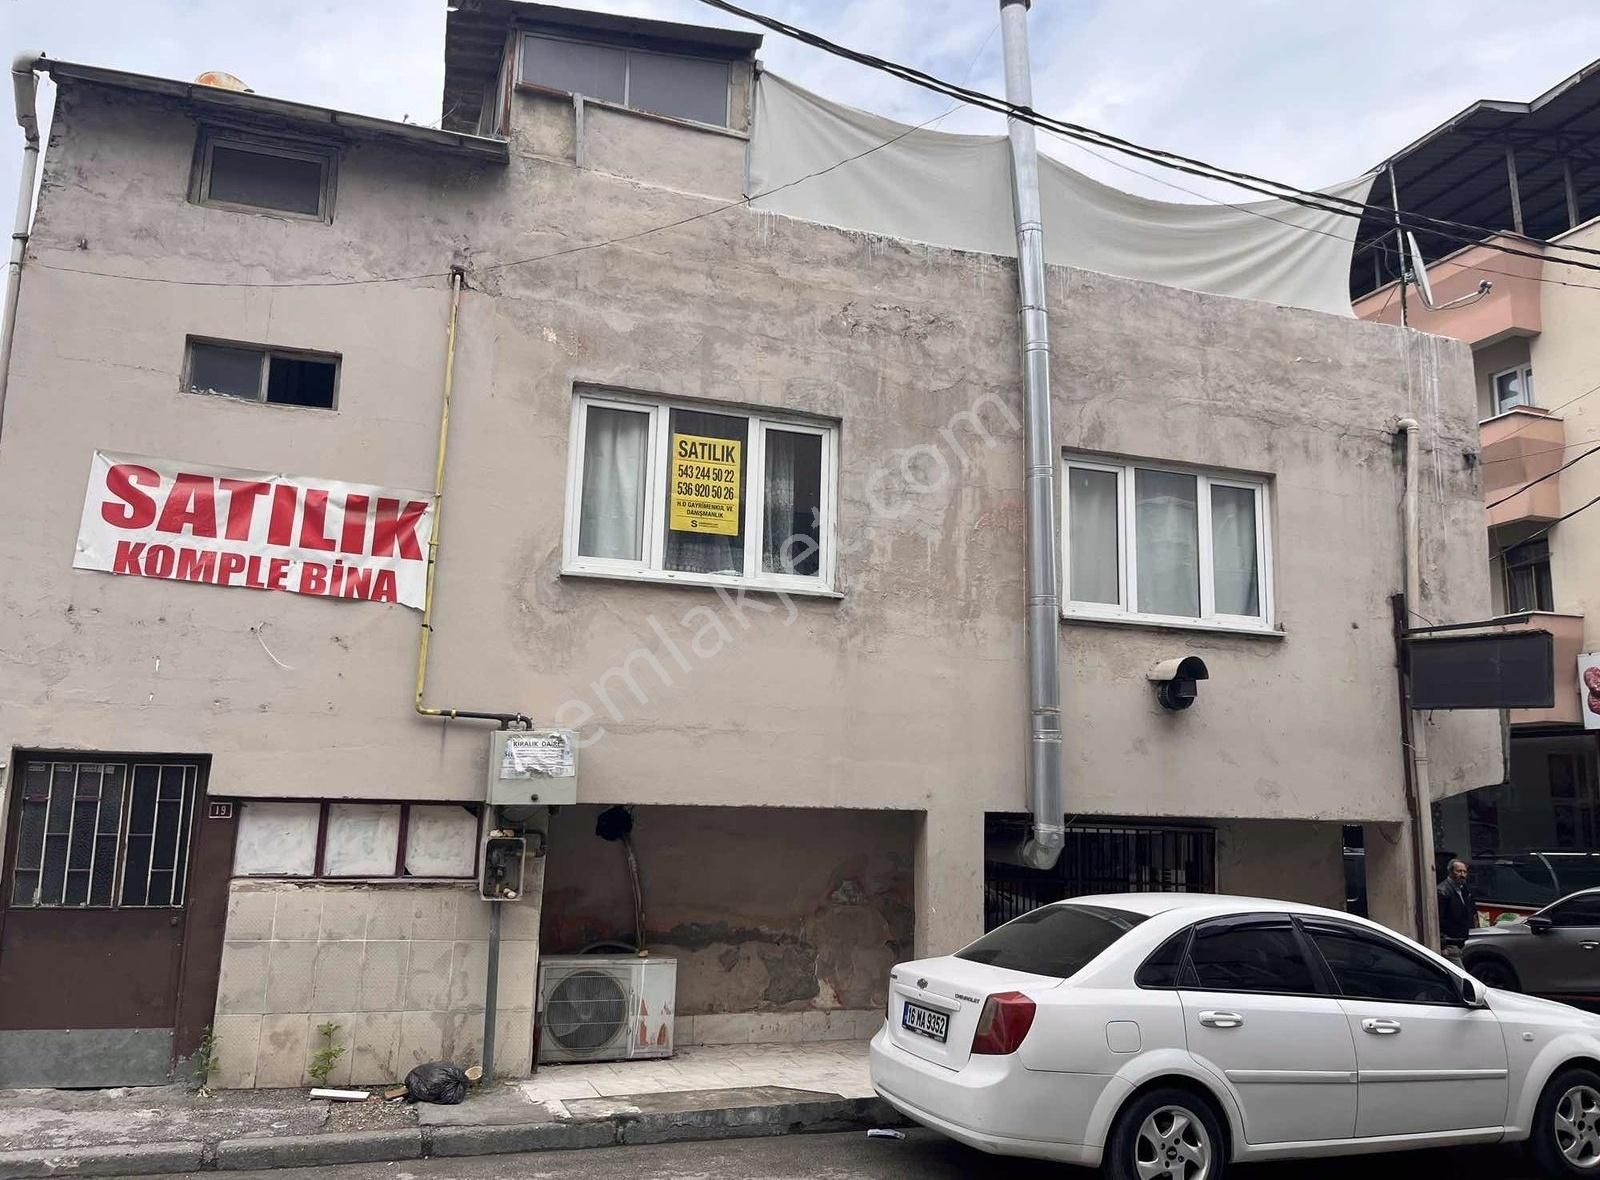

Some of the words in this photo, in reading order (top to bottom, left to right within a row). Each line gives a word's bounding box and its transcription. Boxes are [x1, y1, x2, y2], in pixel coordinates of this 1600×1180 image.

[679, 440, 736, 463] SATILIK
[678, 464, 694, 479] 543
[695, 466, 711, 480] 244
[712, 468, 723, 482] 50
[724, 469, 735, 483] 22
[677, 482, 693, 496] 536
[694, 483, 710, 498] 920
[711, 485, 722, 499] 50
[723, 486, 734, 500] 26
[101, 463, 429, 561] SATILIK
[112, 540, 290, 591] KOMPLE
[298, 559, 398, 604] BİNA
[215, 805, 227, 816] 19
[907, 1006, 916, 1025] 16
[926, 1012, 946, 1035] 9352
